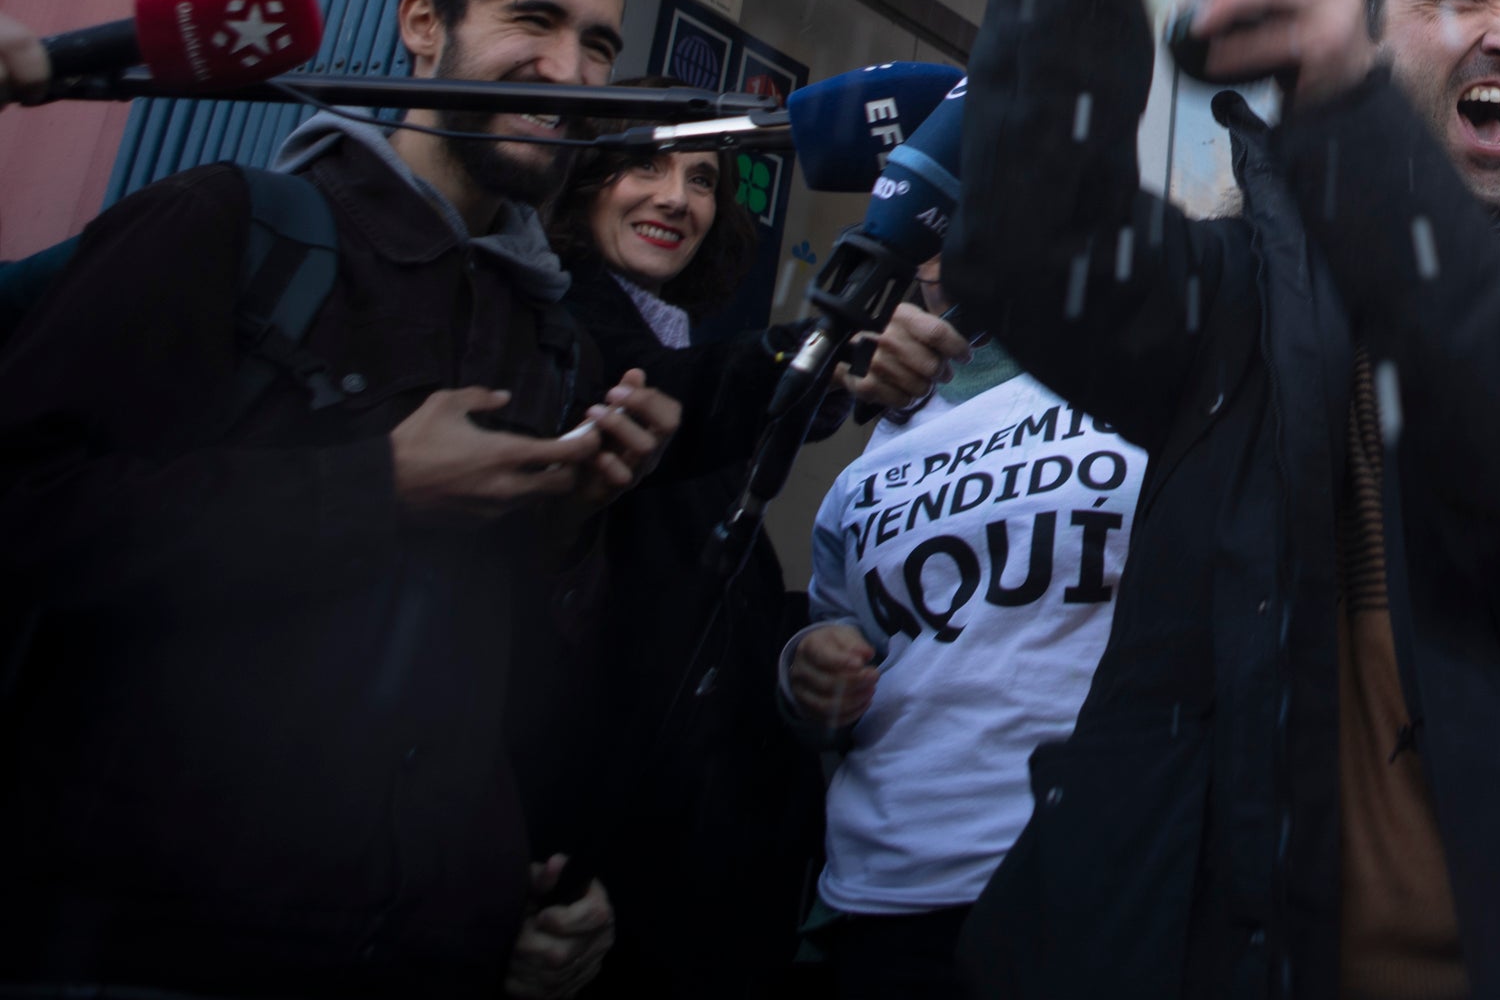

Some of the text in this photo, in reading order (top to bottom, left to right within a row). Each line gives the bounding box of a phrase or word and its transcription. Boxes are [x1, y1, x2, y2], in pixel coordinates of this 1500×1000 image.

[848, 450, 1127, 563] VENDIDO
[854, 462, 912, 510] 1er
[864, 497, 1123, 644] AQUÍ
